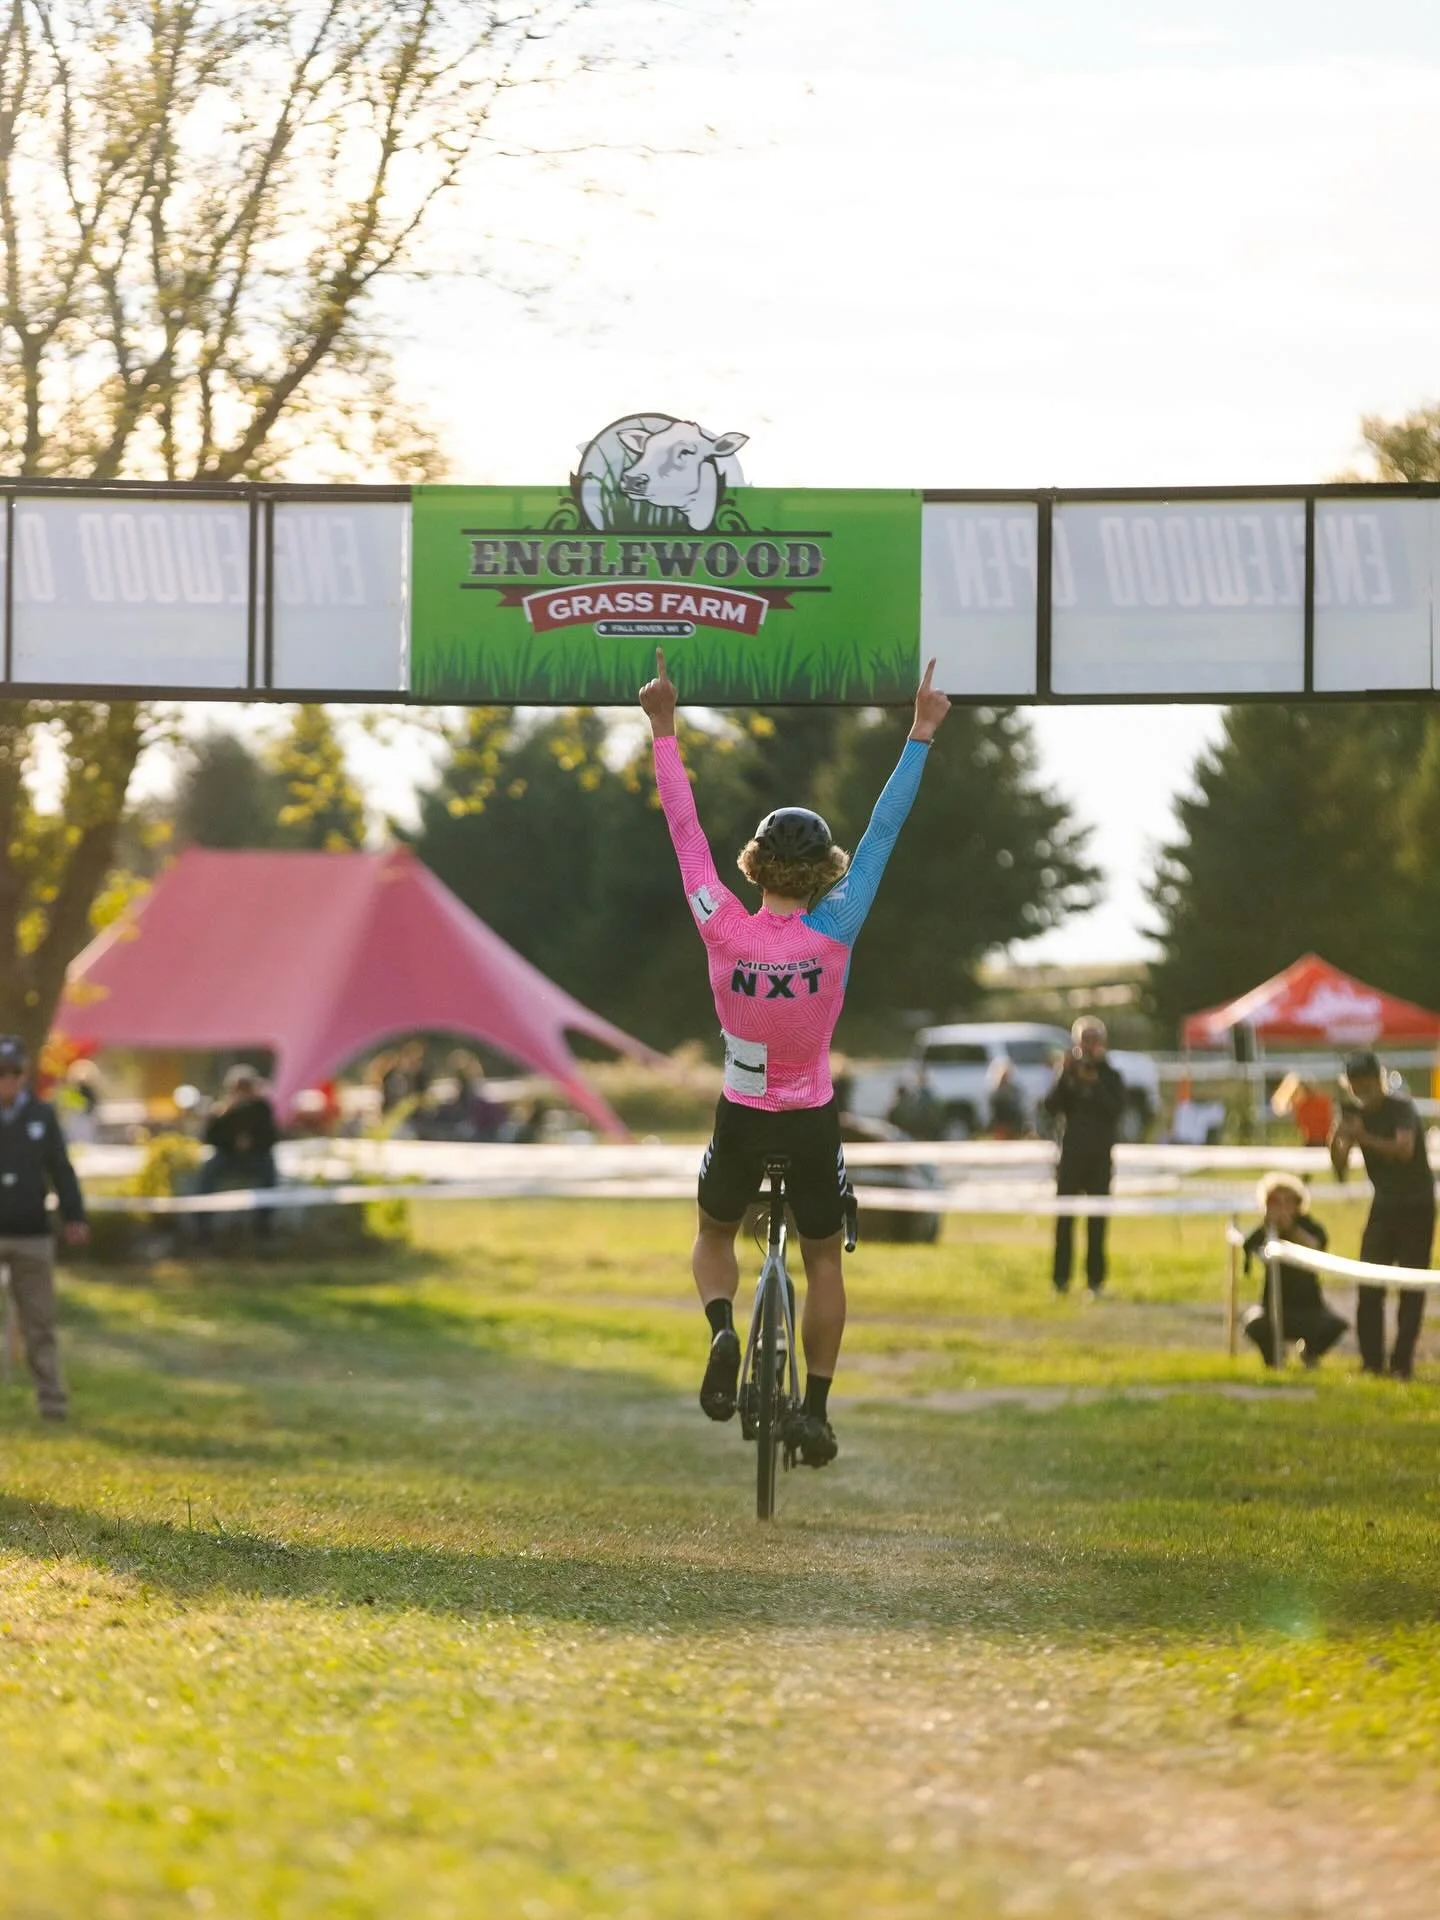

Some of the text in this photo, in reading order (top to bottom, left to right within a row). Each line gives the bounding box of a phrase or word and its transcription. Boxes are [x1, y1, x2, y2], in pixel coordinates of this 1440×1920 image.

[469, 540, 825, 579] ENGLEWOOD
[547, 592, 748, 625] GRASS FARM
[736, 957, 819, 972] MIDWEST
[731, 967, 823, 999] NXT
[733, 1058, 766, 1074] 1
